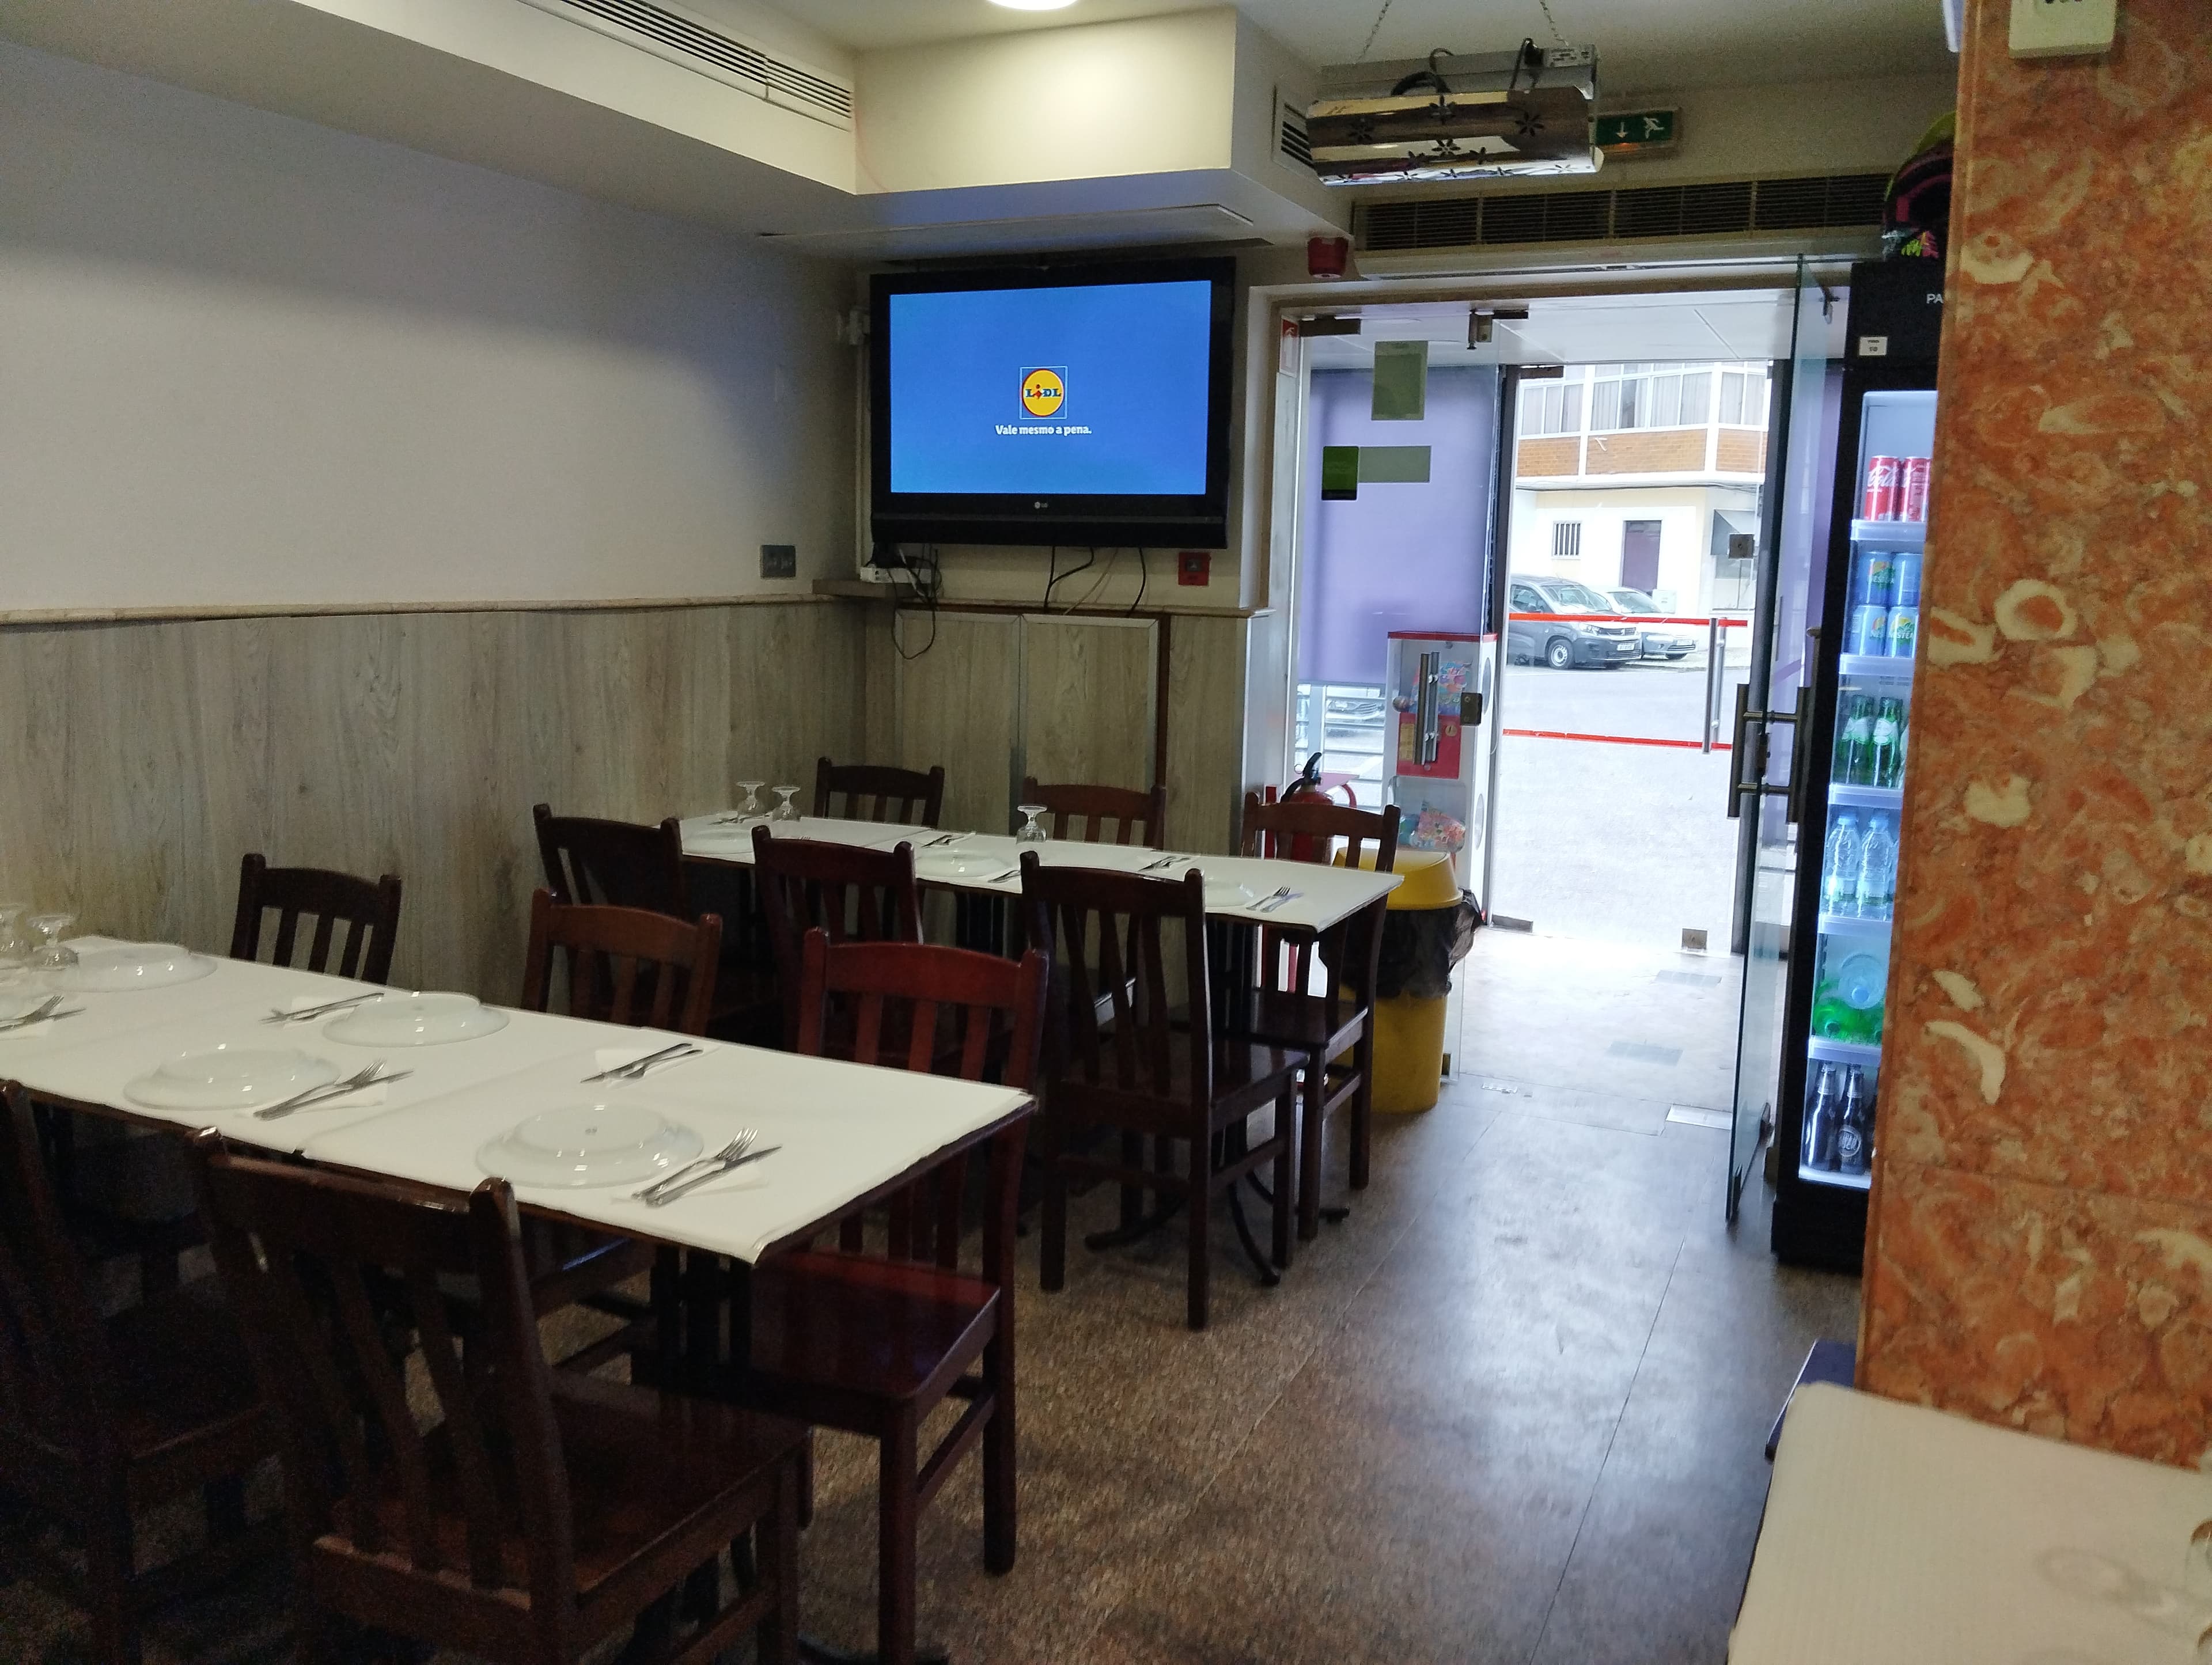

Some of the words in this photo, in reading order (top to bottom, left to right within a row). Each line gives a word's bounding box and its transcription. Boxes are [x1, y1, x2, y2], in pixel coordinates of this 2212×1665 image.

[995, 424, 1018, 435] Vale
[1018, 426, 1055, 435] mesmo
[1055, 426, 1063, 435] a
[1063, 425, 1093, 437] pena.
